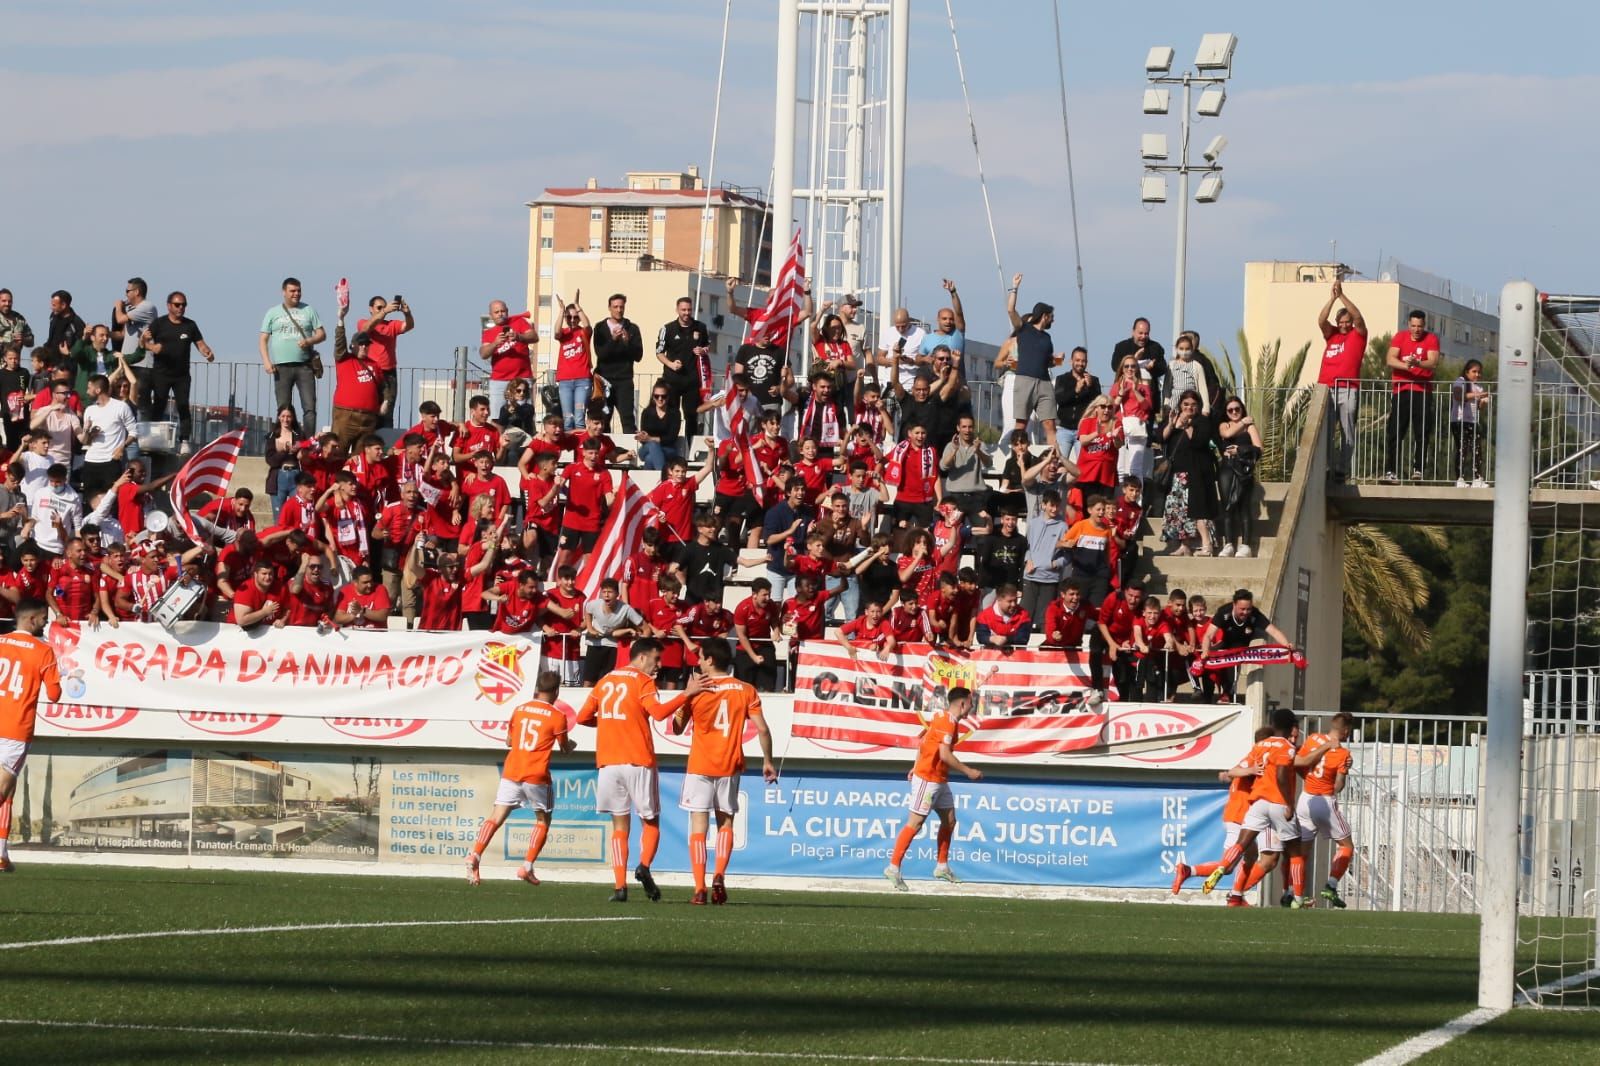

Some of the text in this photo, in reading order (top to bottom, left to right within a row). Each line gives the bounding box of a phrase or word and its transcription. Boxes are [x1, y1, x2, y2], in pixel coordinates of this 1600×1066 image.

[95, 641, 472, 690] GRADA D'ANIMACIÓ
[0, 657, 24, 700] 24
[601, 681, 628, 719] 22
[713, 698, 730, 738] 4
[519, 717, 542, 751] 15
[392, 769, 460, 783] Les millors
[392, 784, 474, 799] instal·lacions
[765, 789, 1113, 815] EL TEU APARCAT AL COSTAT DE
[391, 799, 457, 812] i un servei
[1162, 796, 1188, 820] RE
[456, 815, 474, 828] les
[765, 815, 798, 836] LA
[805, 817, 901, 839] CIUTAT
[954, 821, 986, 842] LA
[994, 819, 1117, 847] JUSTÍCIA
[153, 838, 183, 849] Ronda
[391, 828, 426, 840] hores
[436, 829, 455, 841] els
[1161, 823, 1188, 847] GE
[337, 844, 358, 854] Gran
[360, 845, 375, 855] Via
[390, 842, 416, 854] dies
[420, 843, 435, 855] de
[791, 842, 834, 861] Plaça
[840, 844, 913, 860] Francec
[970, 848, 991, 863] de
[996, 848, 1089, 867] l'Hospitalet
[1160, 850, 1187, 874] SA
